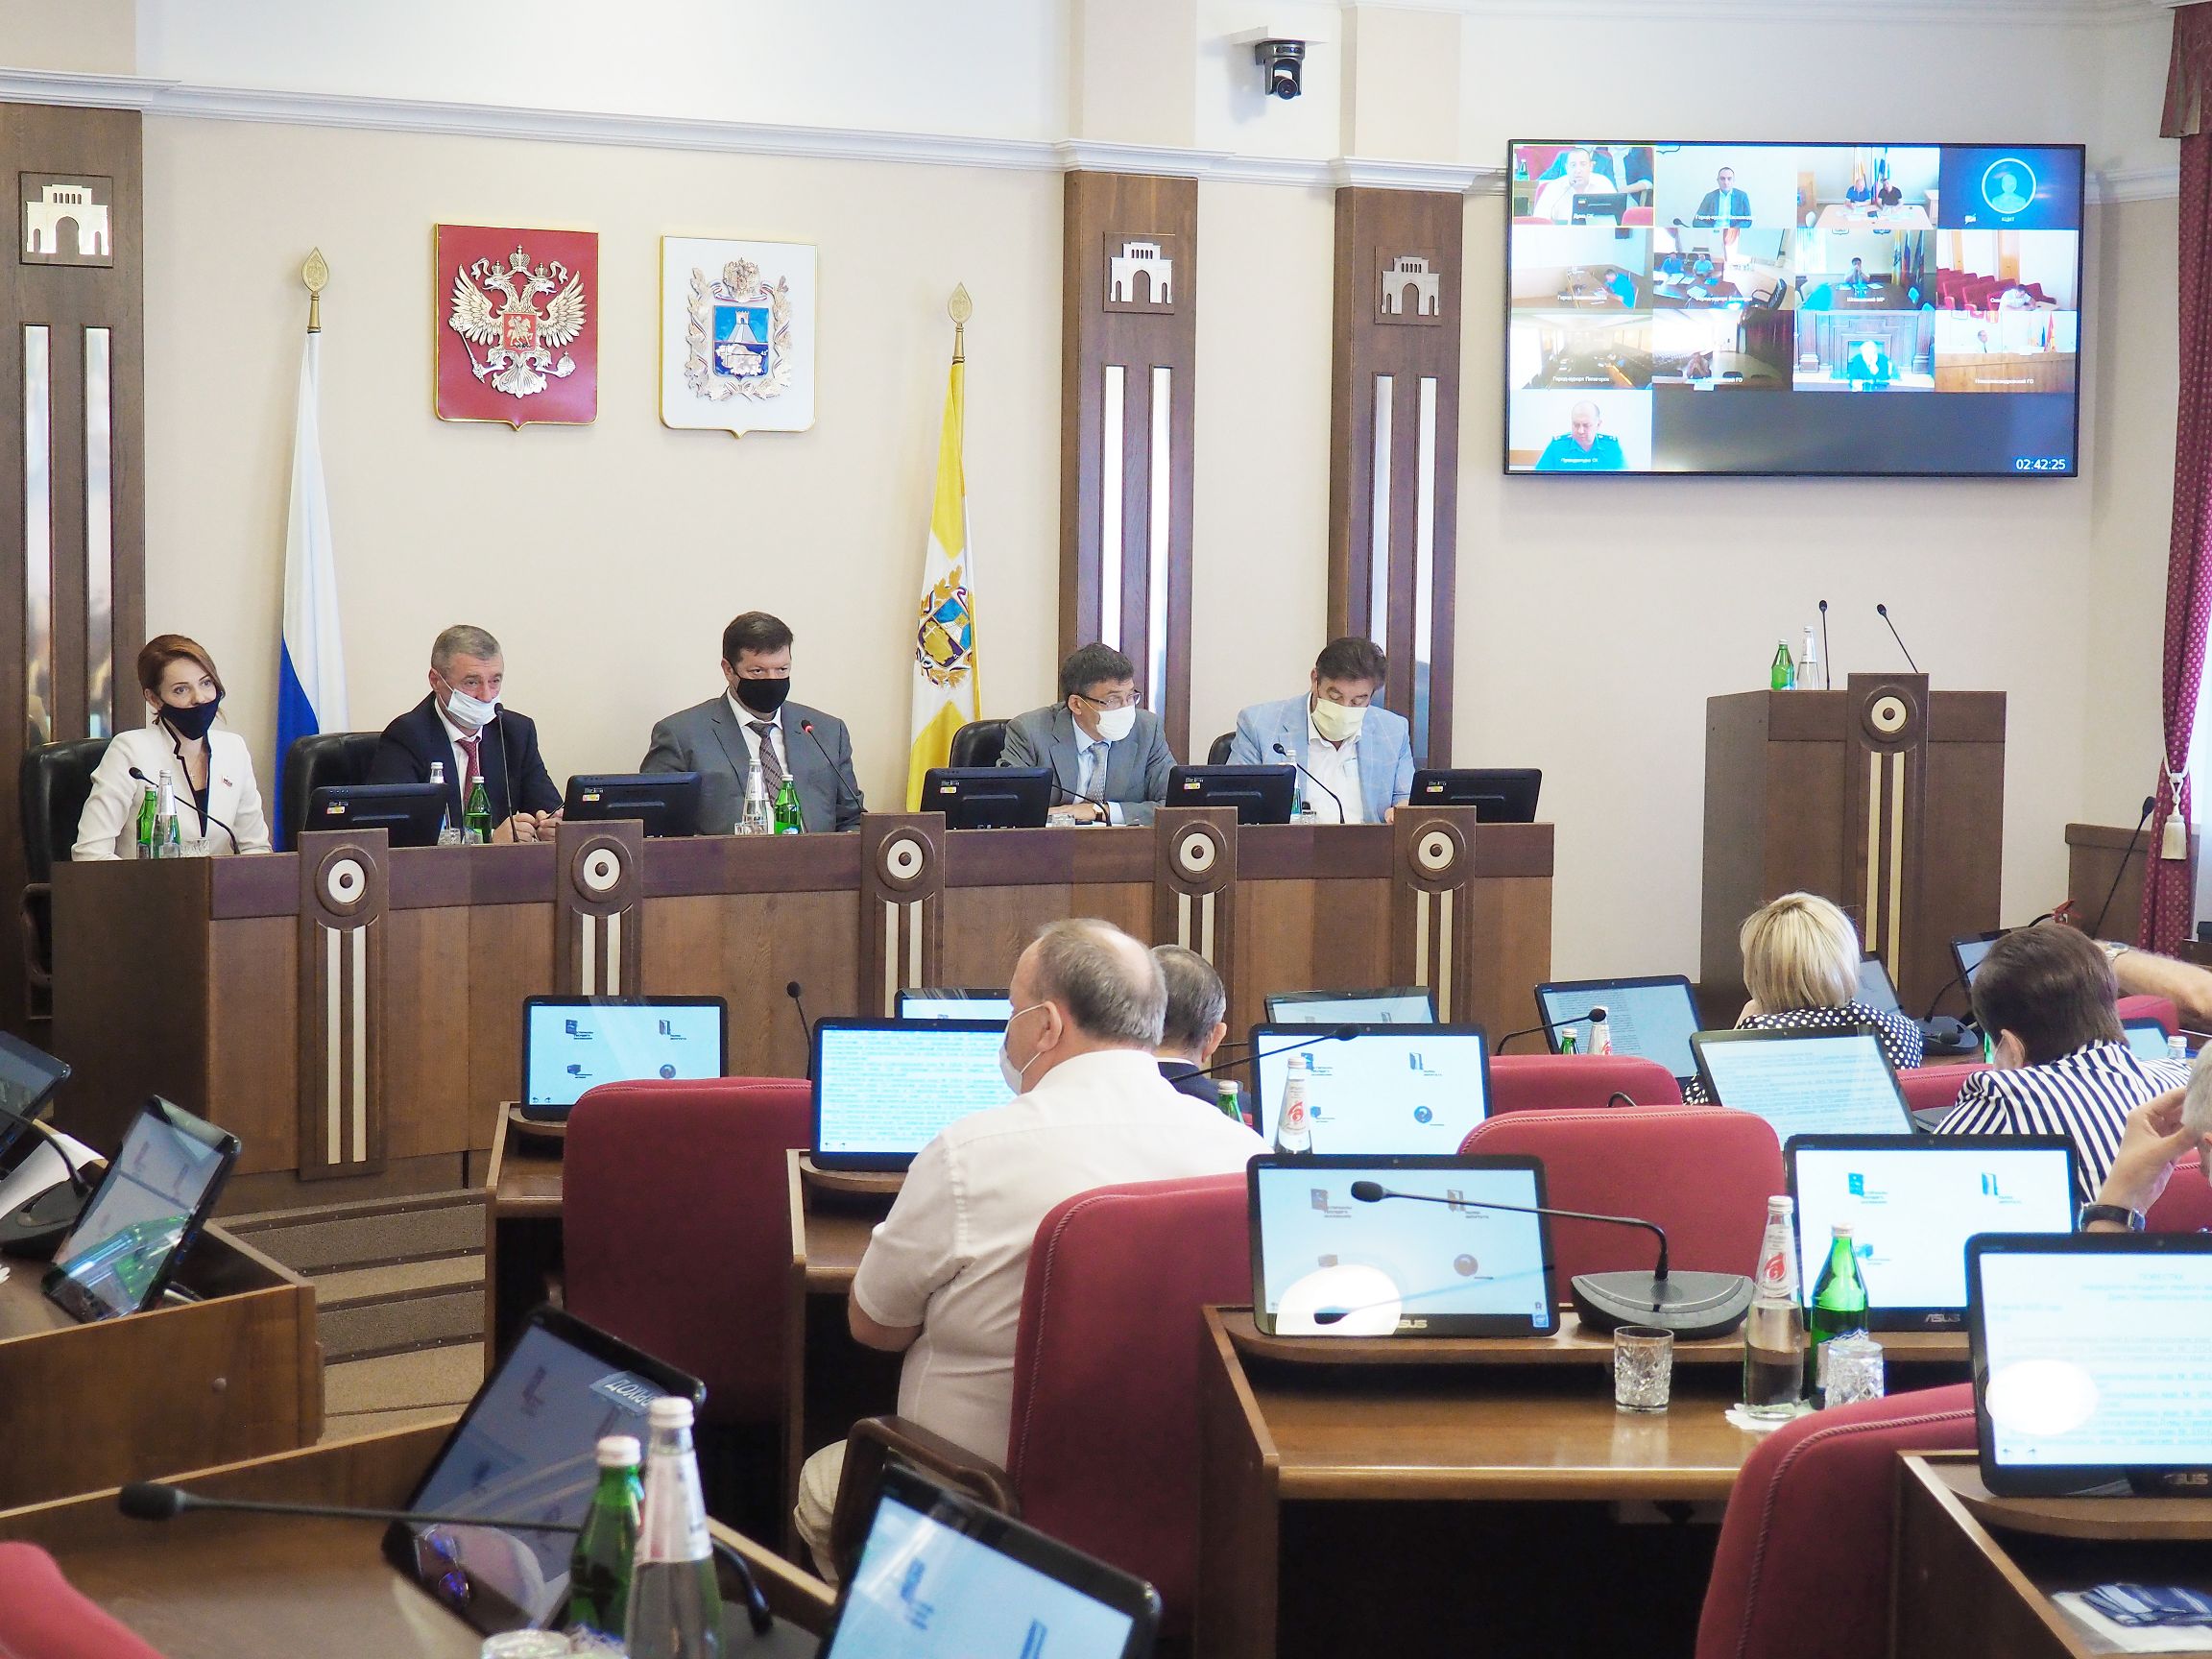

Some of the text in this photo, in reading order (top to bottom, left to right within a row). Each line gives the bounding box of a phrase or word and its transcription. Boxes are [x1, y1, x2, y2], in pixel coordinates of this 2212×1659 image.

[2015, 458, 2066, 470] 02:42:25
[1925, 1313, 1960, 1323] ASUS
[1396, 1319, 1428, 1329] SUS
